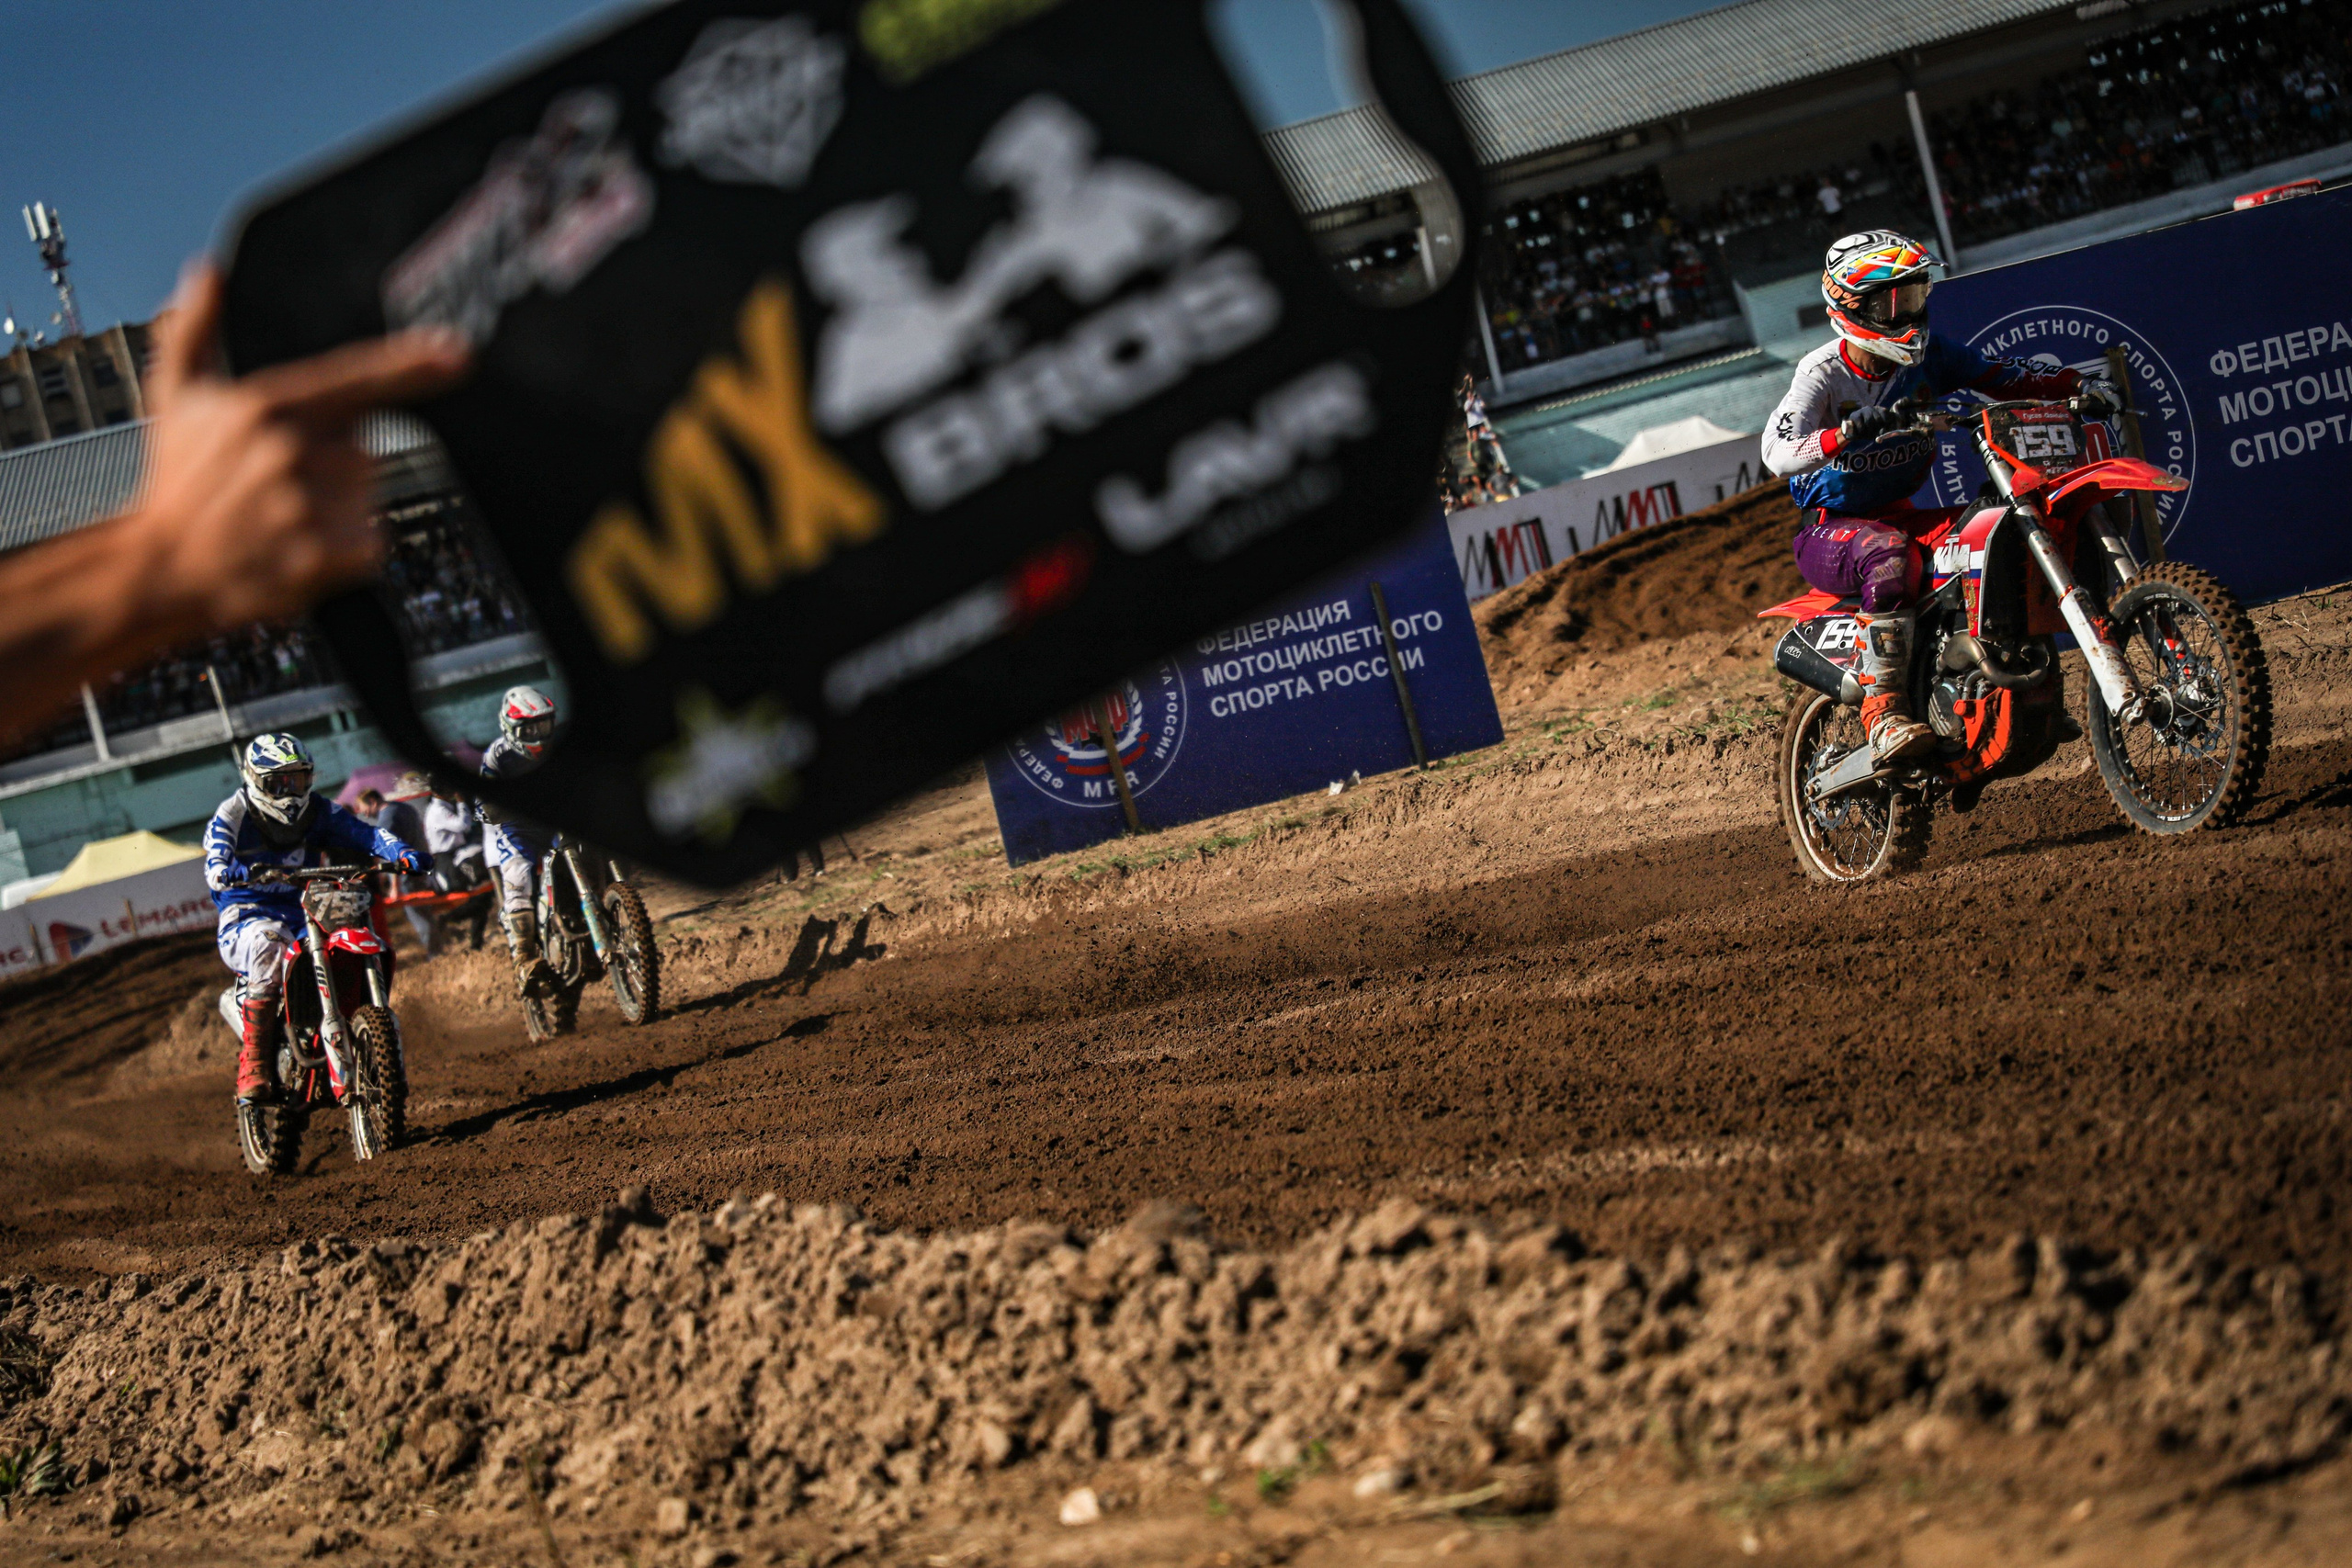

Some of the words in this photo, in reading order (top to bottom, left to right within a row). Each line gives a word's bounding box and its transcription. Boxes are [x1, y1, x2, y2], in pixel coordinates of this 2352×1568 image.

[2210, 321, 2352, 378] ФЕДЕРА
[2008, 424, 2077, 460] 159
[2230, 412, 2352, 468] СПОРТ
[1933, 536, 1971, 574] KTM
[1196, 600, 1351, 655] ФЕДЕРАЦИЯ
[1815, 619, 1859, 650] 159
[1210, 675, 1314, 717] СПОРТА
[1015, 738, 1064, 789] ФЕДЕРА
[1154, 691, 1179, 759] РОССИИ
